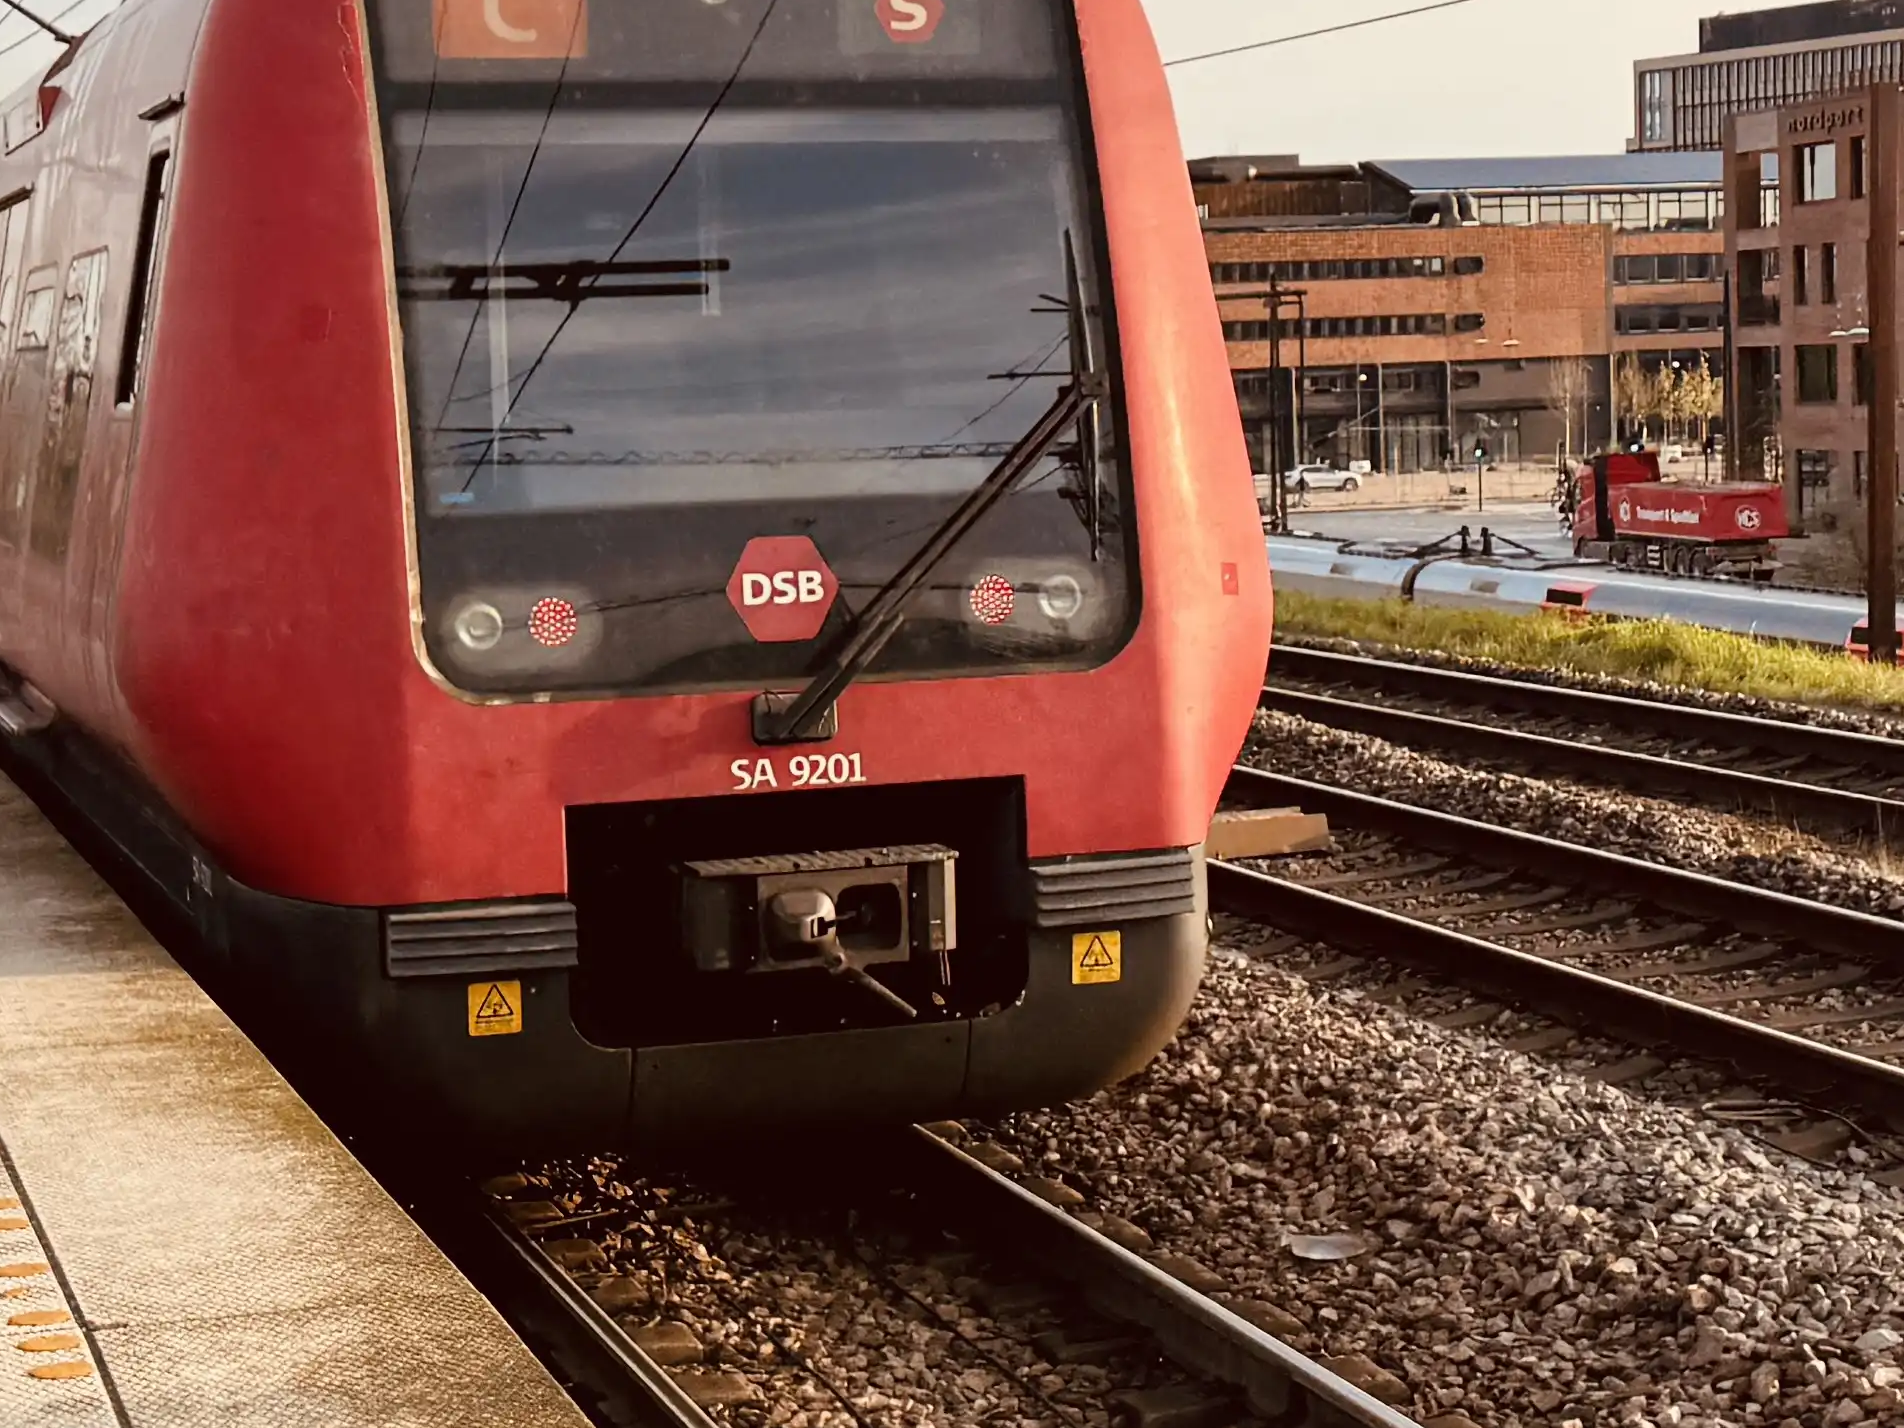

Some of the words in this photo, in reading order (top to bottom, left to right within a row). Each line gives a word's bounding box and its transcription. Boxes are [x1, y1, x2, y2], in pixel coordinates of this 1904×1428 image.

[742, 570, 825, 606] DSB
[730, 758, 778, 790] SA
[789, 752, 867, 787] 9201
